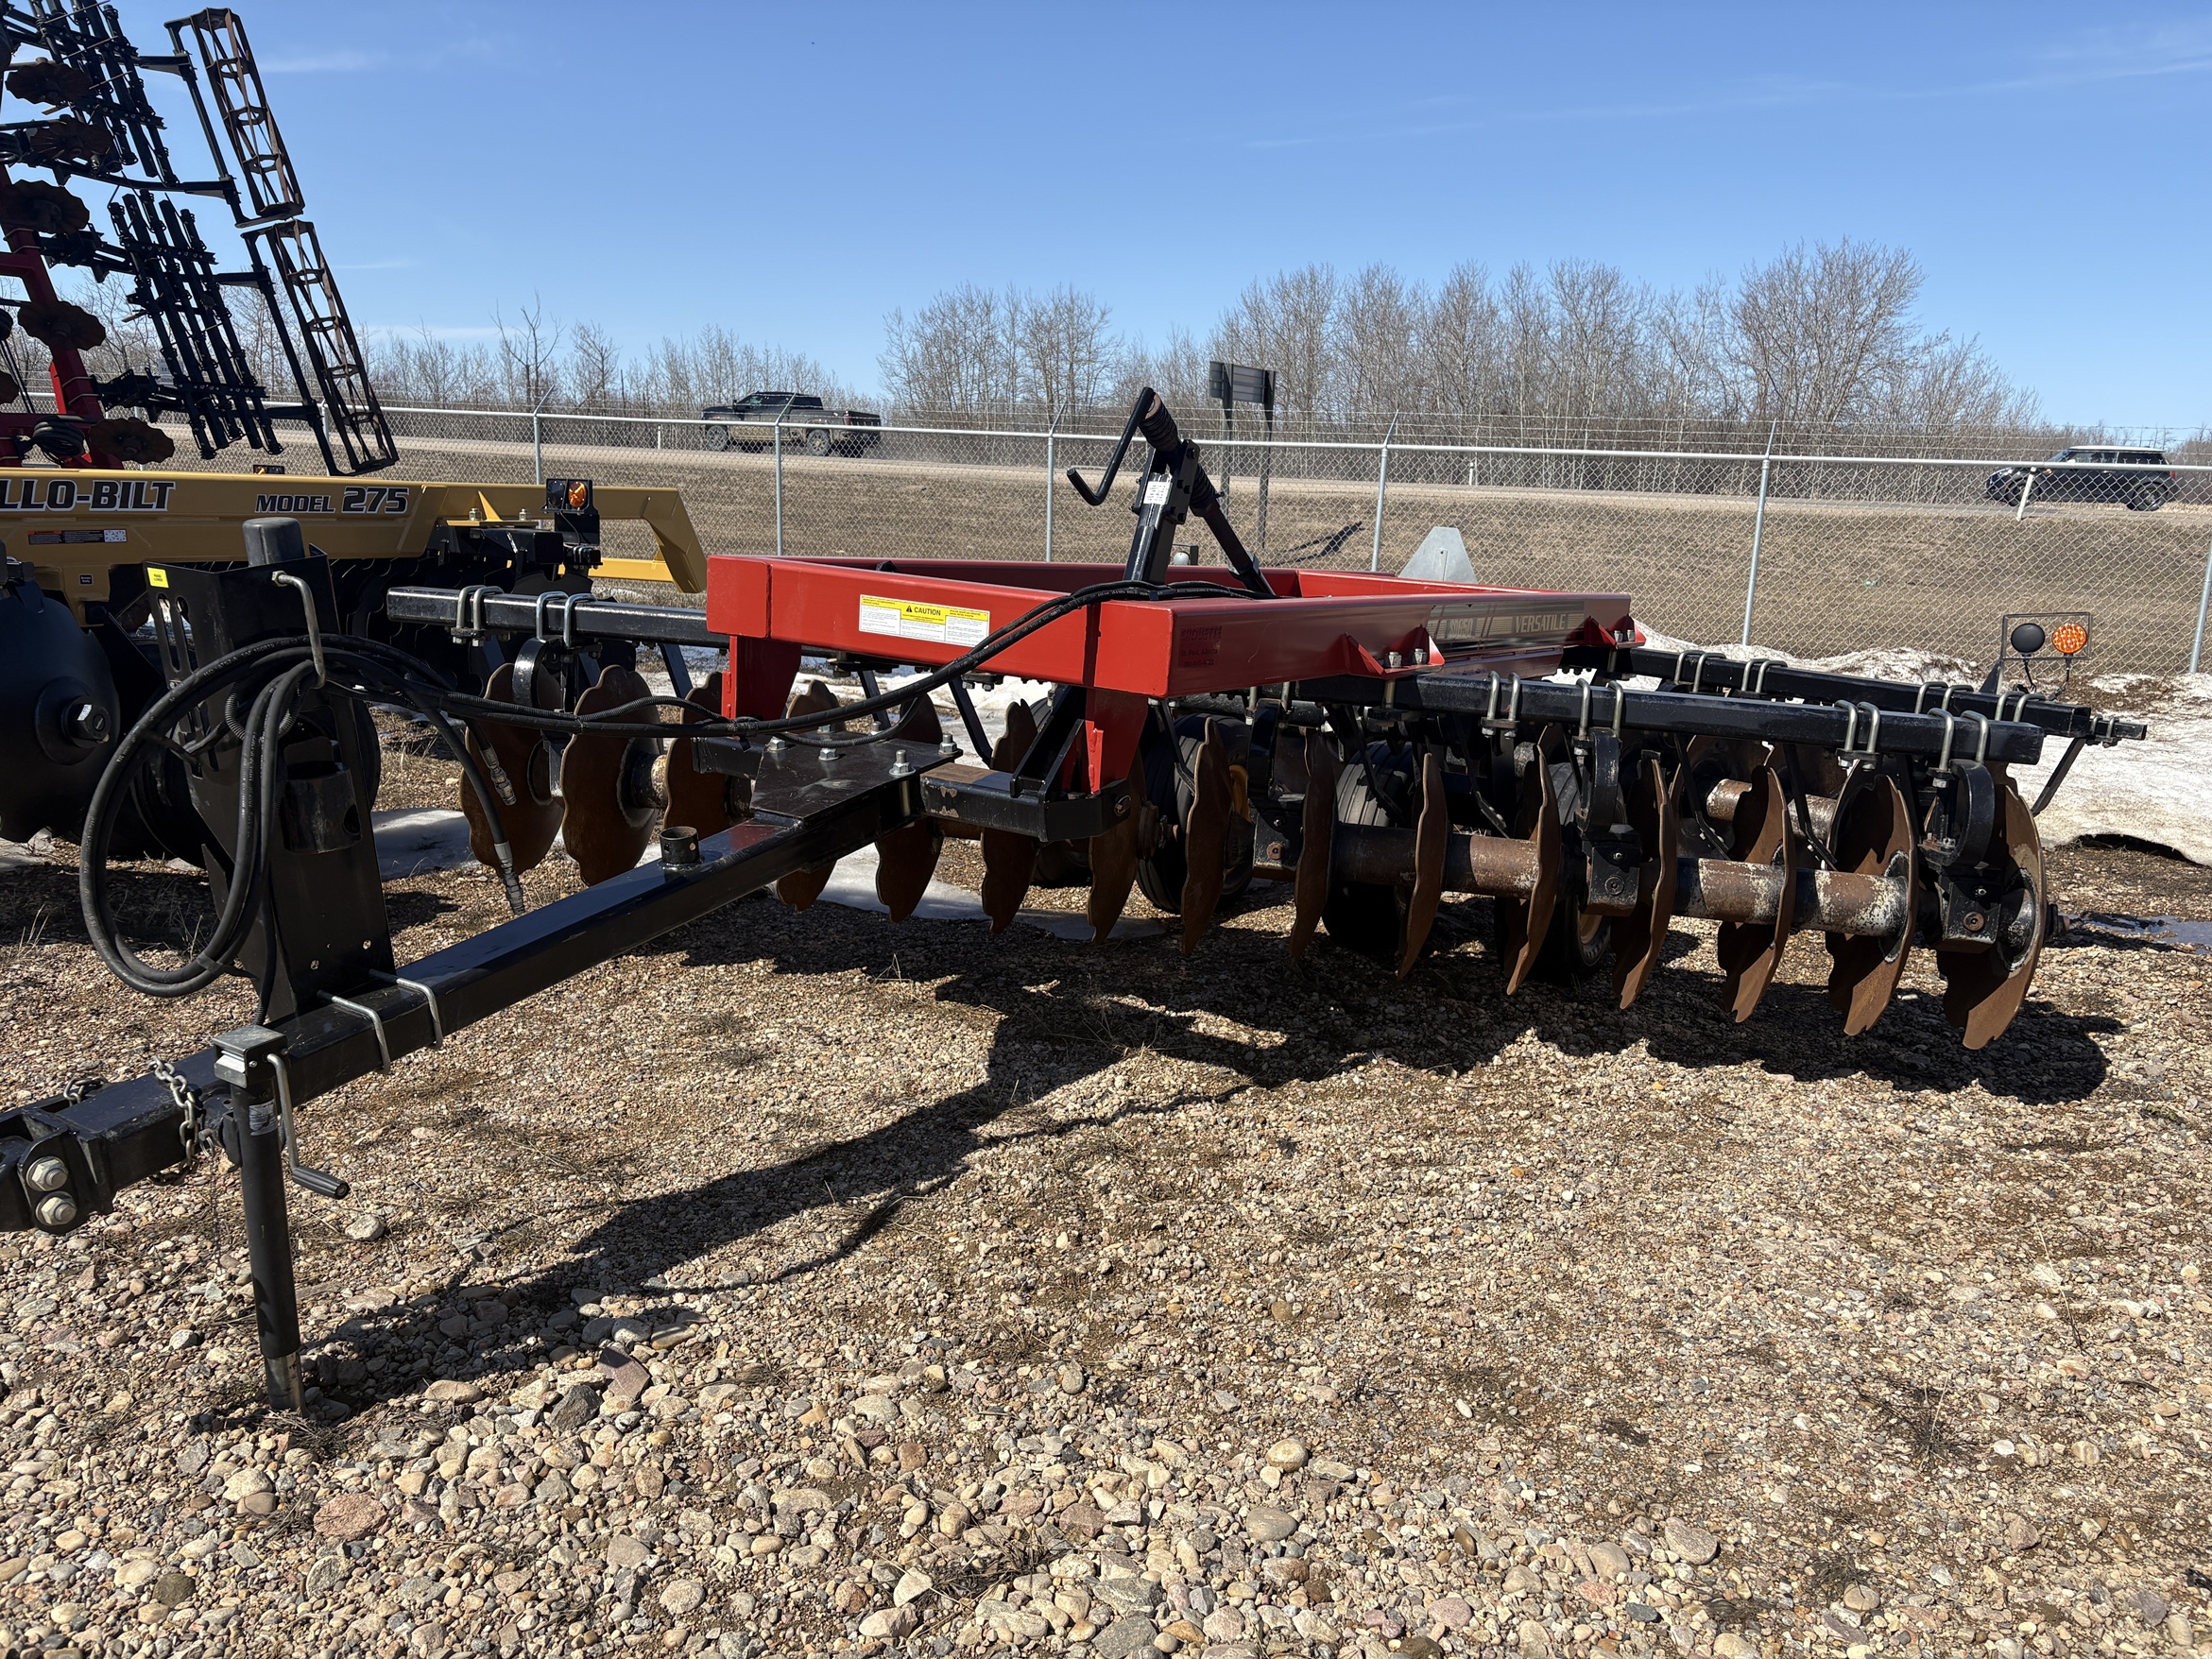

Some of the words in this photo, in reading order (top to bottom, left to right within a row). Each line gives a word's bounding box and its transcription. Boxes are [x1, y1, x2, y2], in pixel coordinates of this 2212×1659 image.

[254, 494, 335, 514] MODEL
[341, 486, 409, 514] 275
[914, 607, 941, 616] CAUTION
[1516, 614, 1566, 633] VERSATILE
